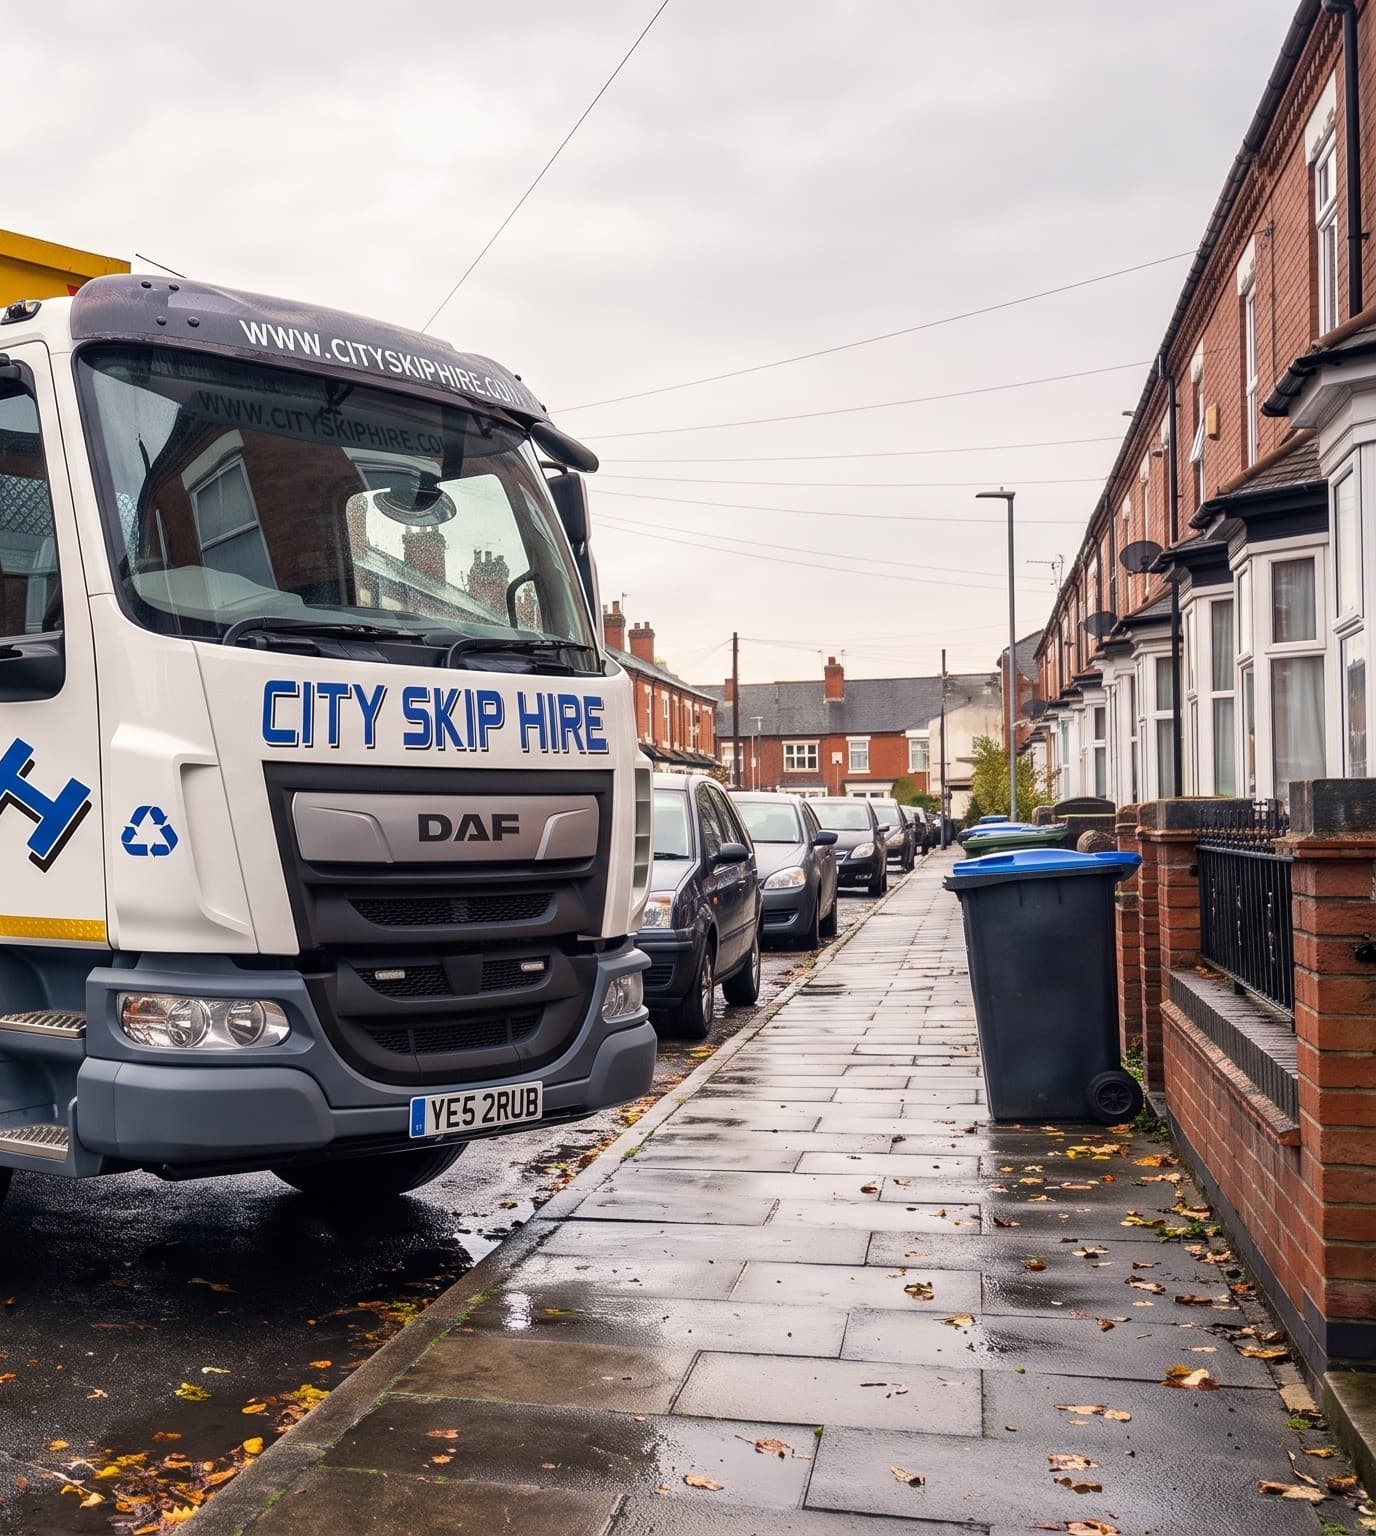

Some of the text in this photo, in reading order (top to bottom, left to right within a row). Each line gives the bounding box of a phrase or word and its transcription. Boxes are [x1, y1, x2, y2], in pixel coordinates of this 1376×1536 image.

[262, 680, 609, 754] CITY SKIP HIRE
[417, 813, 520, 842] DAF
[431, 1087, 539, 1131] YE5 2RUB
